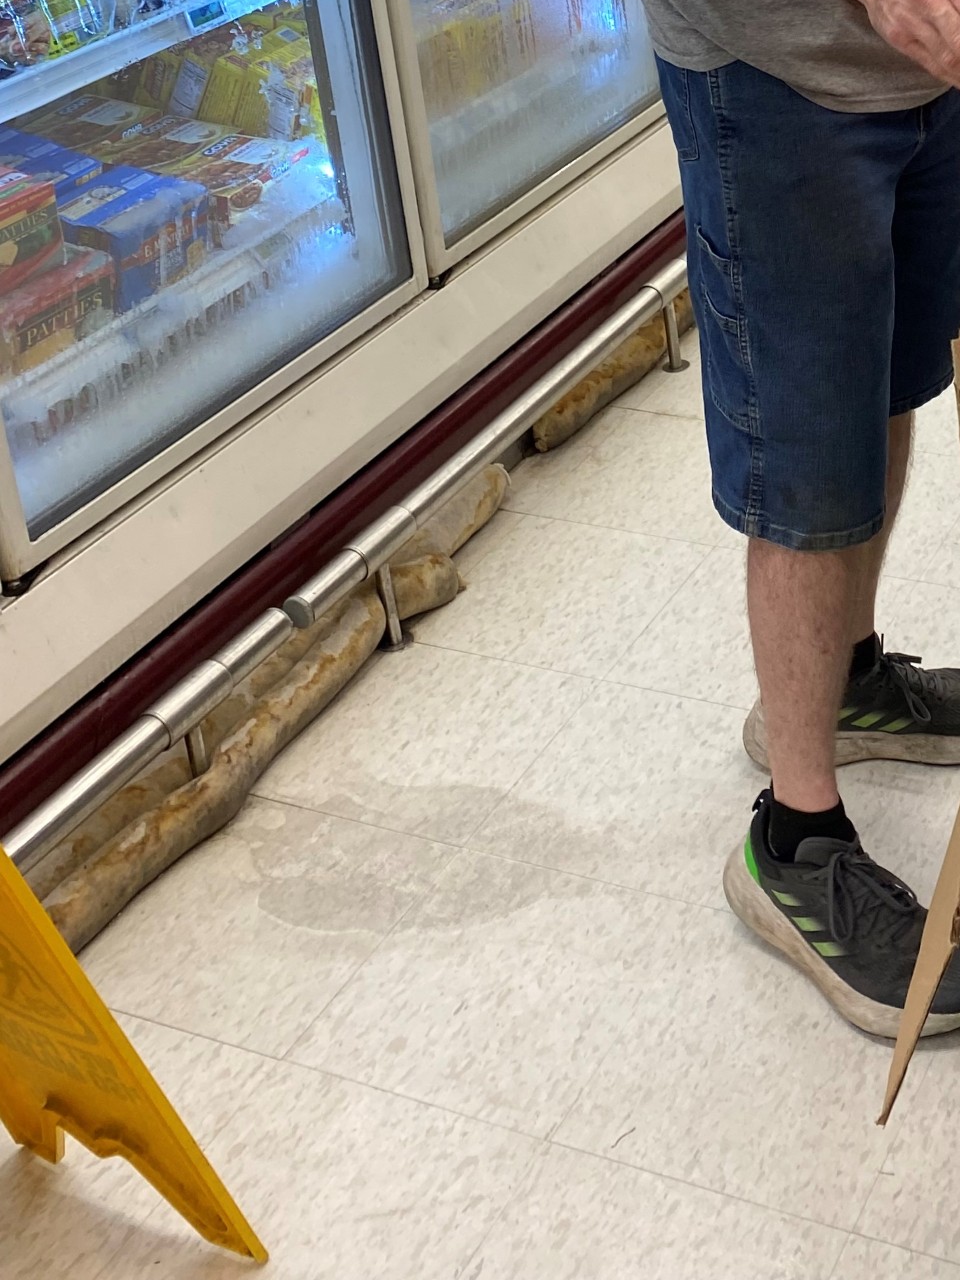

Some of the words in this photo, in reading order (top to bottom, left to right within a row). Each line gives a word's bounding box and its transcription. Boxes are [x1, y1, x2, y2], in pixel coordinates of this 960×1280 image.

[203, 135, 237, 156] GOYA
[0, 210, 49, 240] ATTIES
[26, 291, 103, 346] PATTIES
